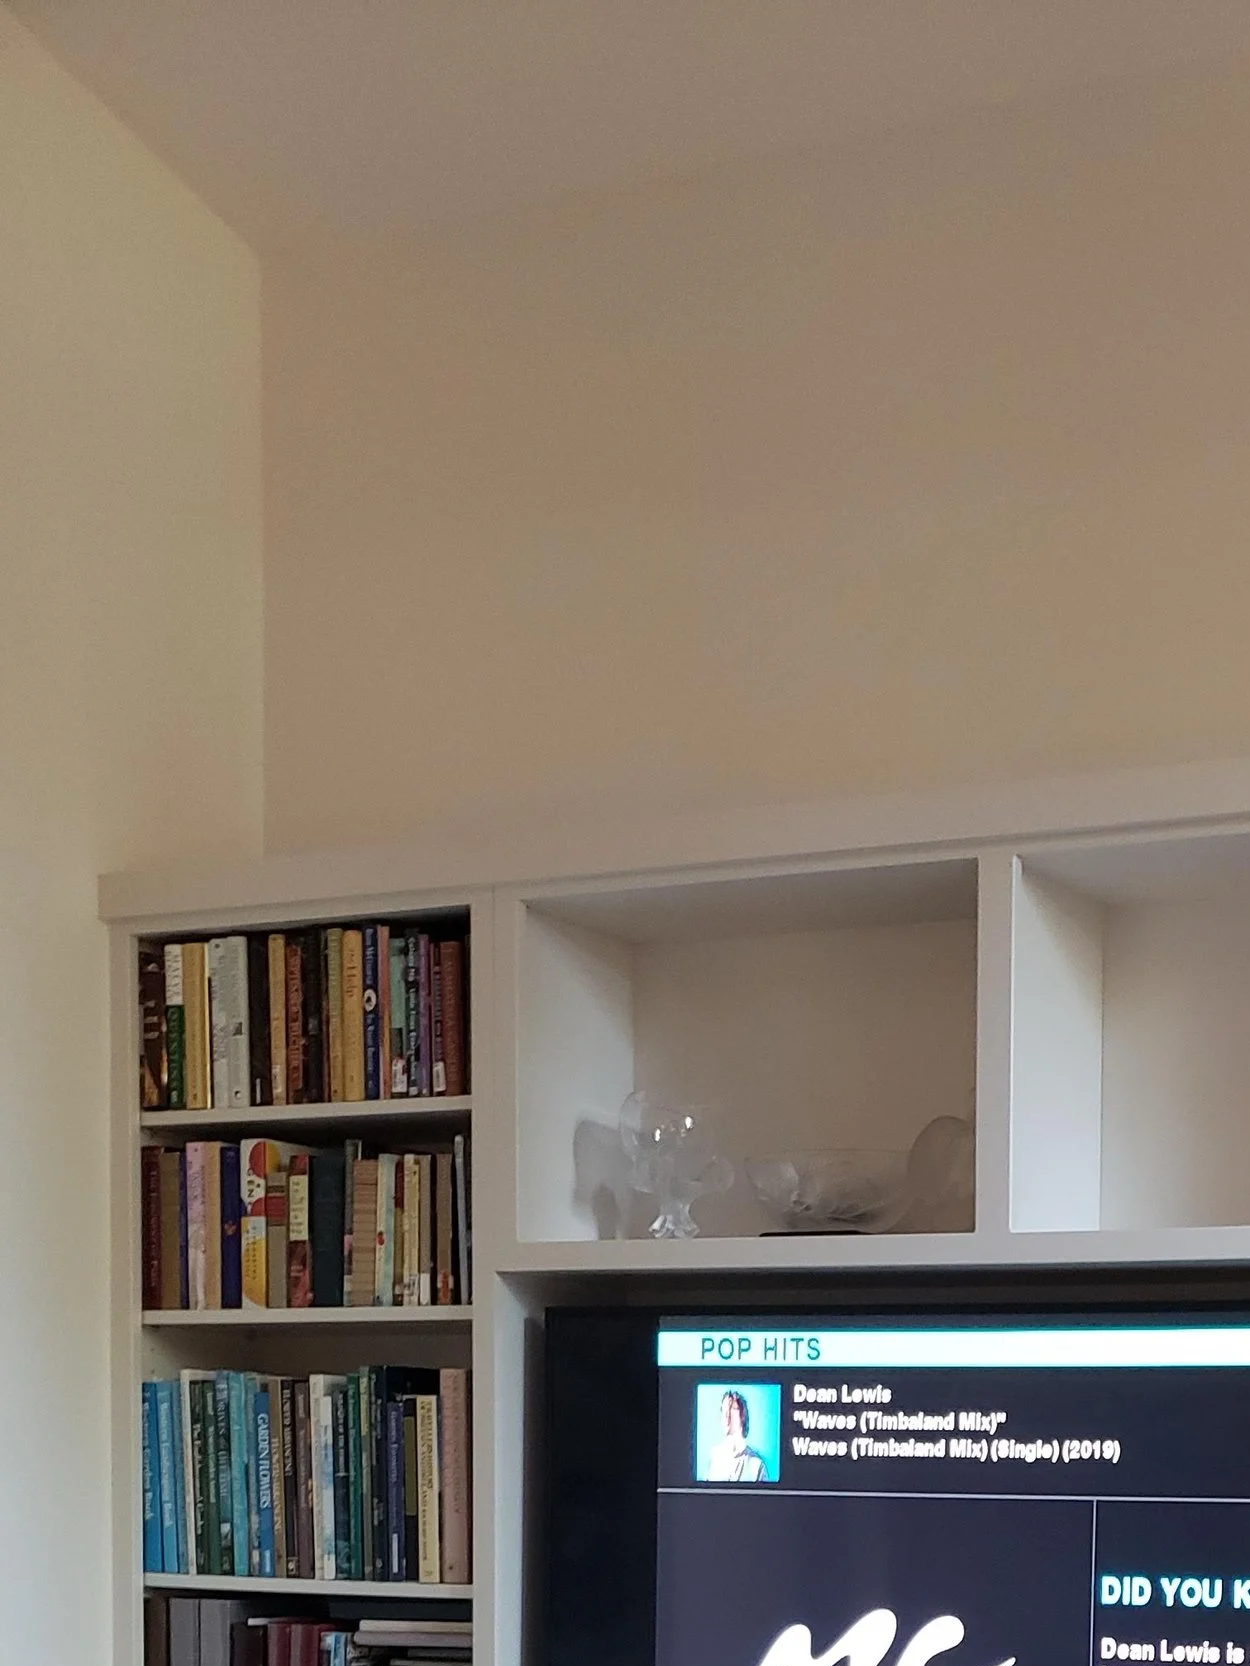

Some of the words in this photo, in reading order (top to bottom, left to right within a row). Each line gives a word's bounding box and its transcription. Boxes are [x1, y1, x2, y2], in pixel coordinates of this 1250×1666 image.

[701, 1337, 752, 1361] POP
[763, 1338, 821, 1361] HITS
[793, 1384, 838, 1404] Dean
[841, 1385, 892, 1404] Lewis
[257, 1413, 270, 1459] GARDEN
[792, 1438, 847, 1458] Waves
[850, 1438, 946, 1461] (Timbaland
[948, 1439, 988, 1463] Mix)
[989, 1439, 1061, 1463] (Single)
[1062, 1440, 1122, 1464] (2019)
[259, 1459, 272, 1510] FLOWERS
[1100, 1575, 1151, 1606] DID
[1159, 1577, 1223, 1609] YOU
[1100, 1637, 1155, 1661] Dean
[1160, 1639, 1221, 1664] Lewis
[1226, 1641, 1245, 1665] is
